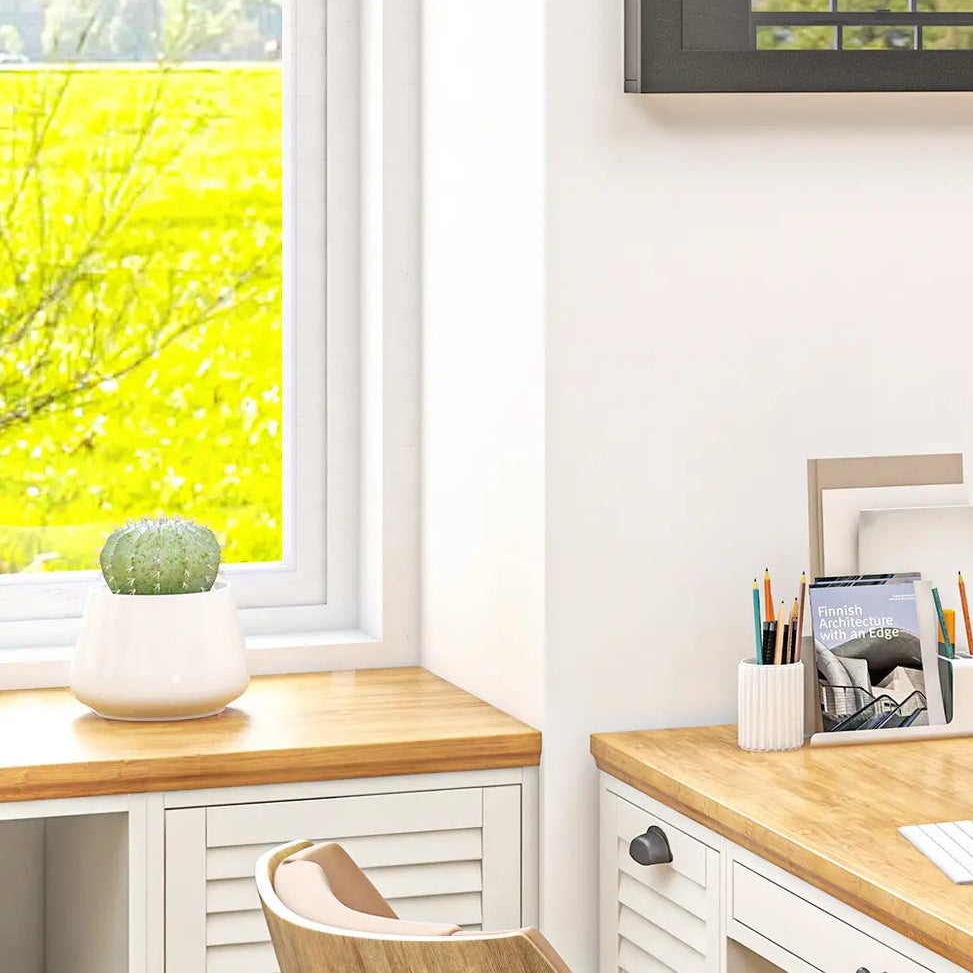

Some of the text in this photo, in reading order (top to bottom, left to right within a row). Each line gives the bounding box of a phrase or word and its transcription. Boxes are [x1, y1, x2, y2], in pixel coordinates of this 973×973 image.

[818, 605, 863, 617] Finnish
[819, 616, 893, 629] Architecture
[821, 627, 899, 640] with an Edge
